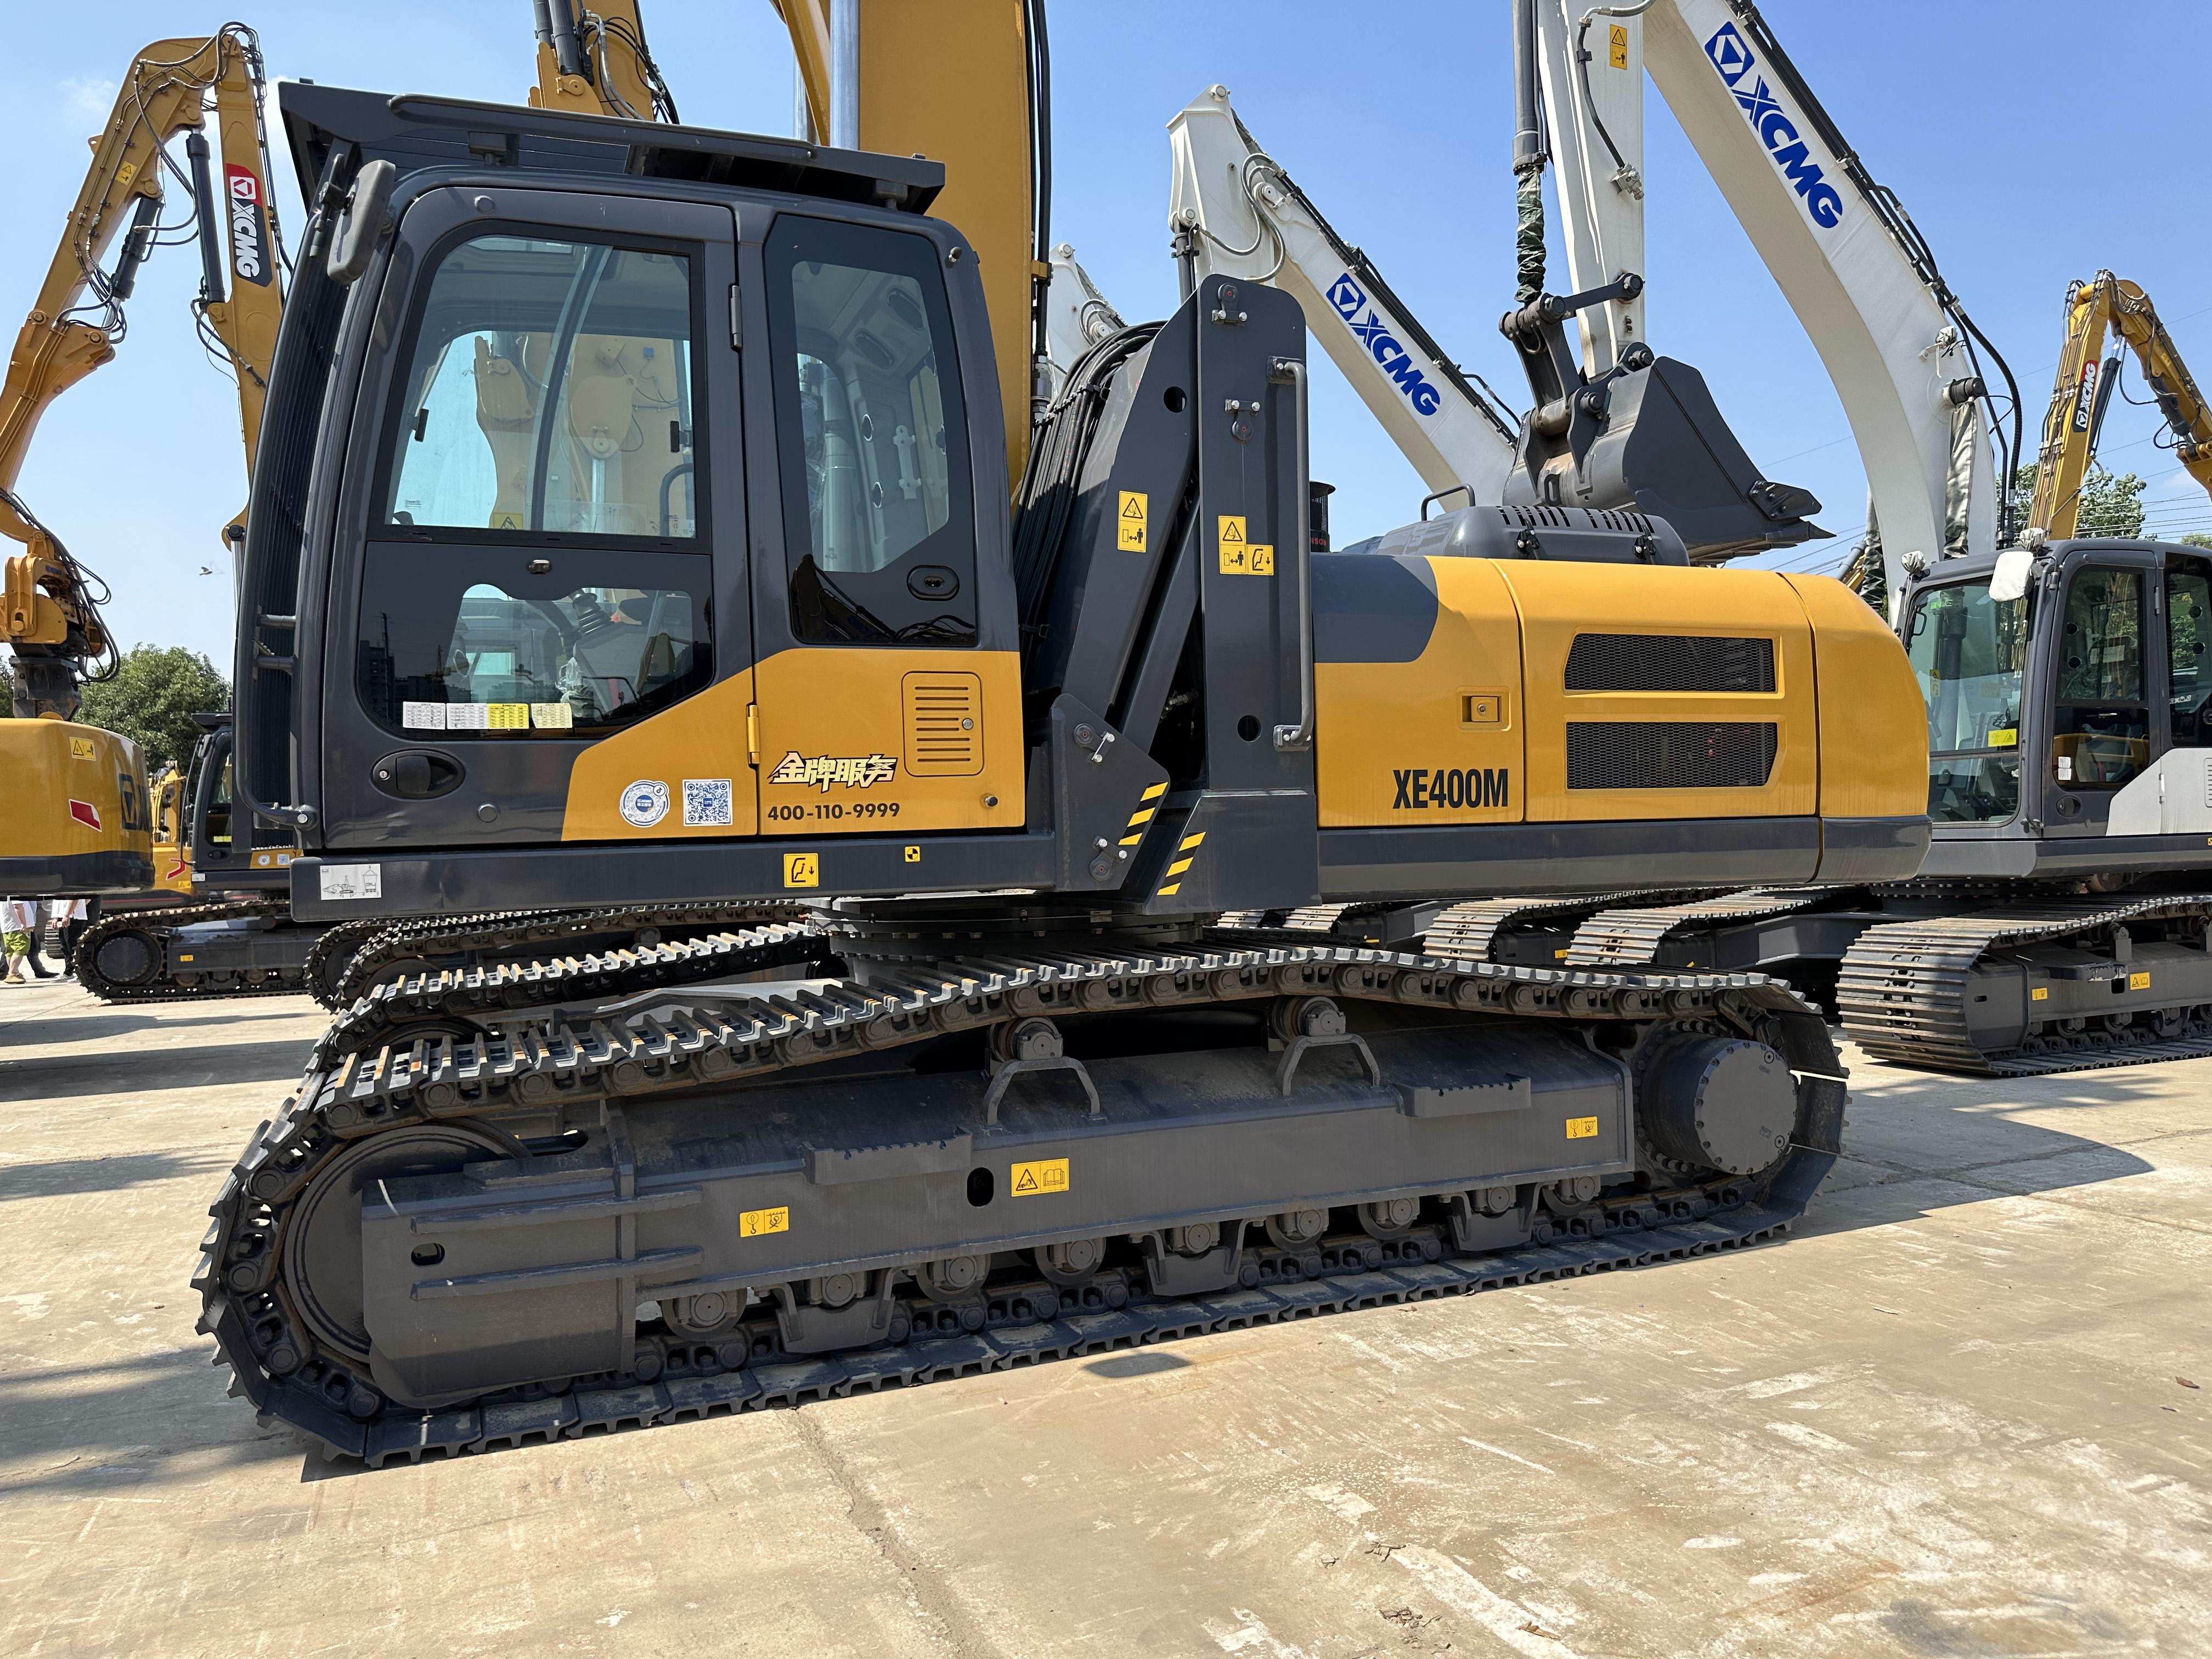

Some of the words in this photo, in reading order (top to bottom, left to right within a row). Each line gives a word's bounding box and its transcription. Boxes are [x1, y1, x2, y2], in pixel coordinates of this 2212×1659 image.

[1730, 74, 1843, 228] XCMG
[232, 198, 260, 277] XCMG
[1348, 309, 1440, 416] XCMG
[2080, 363, 2096, 415] XCMG
[767, 751, 898, 793] 金牌服务
[1392, 769, 1508, 809] XE400M
[768, 803, 900, 821] 400-110-9999
